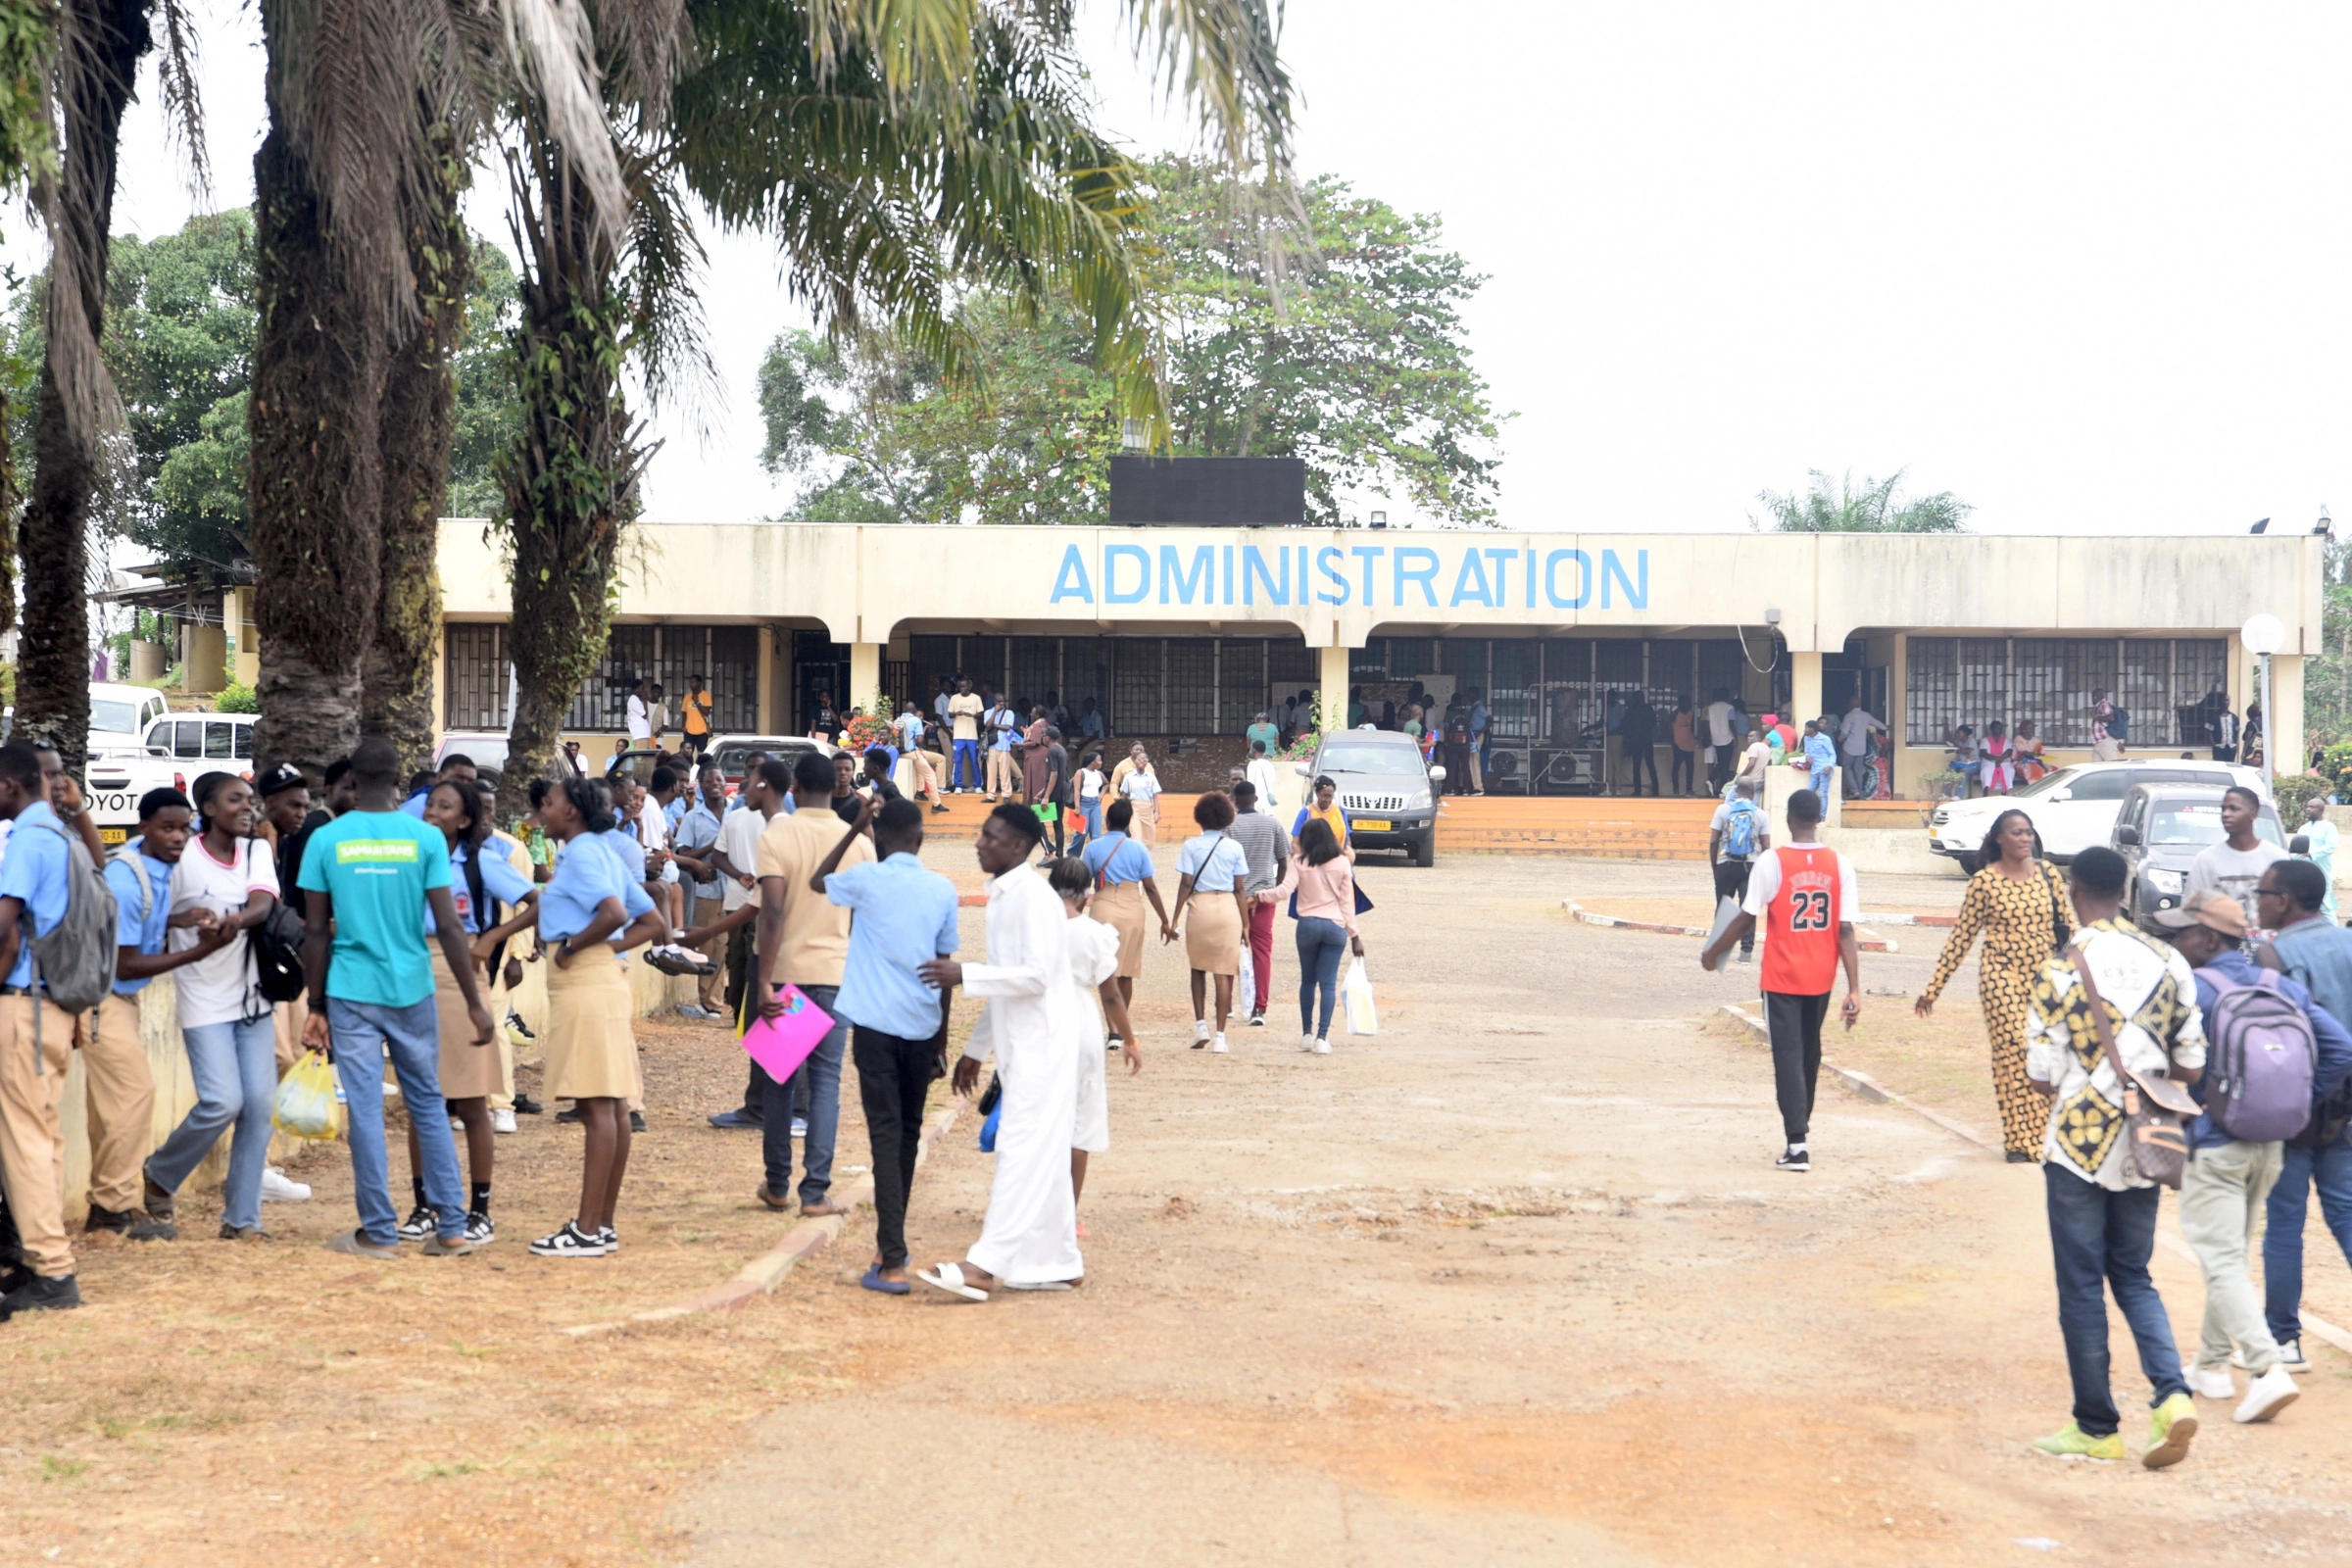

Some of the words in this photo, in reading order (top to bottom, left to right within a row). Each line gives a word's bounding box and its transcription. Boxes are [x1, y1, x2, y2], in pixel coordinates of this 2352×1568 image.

[1050, 544, 1648, 610] ADMINISTRATION
[84, 794, 140, 811] OYOT
[1790, 890, 1832, 932] 23
